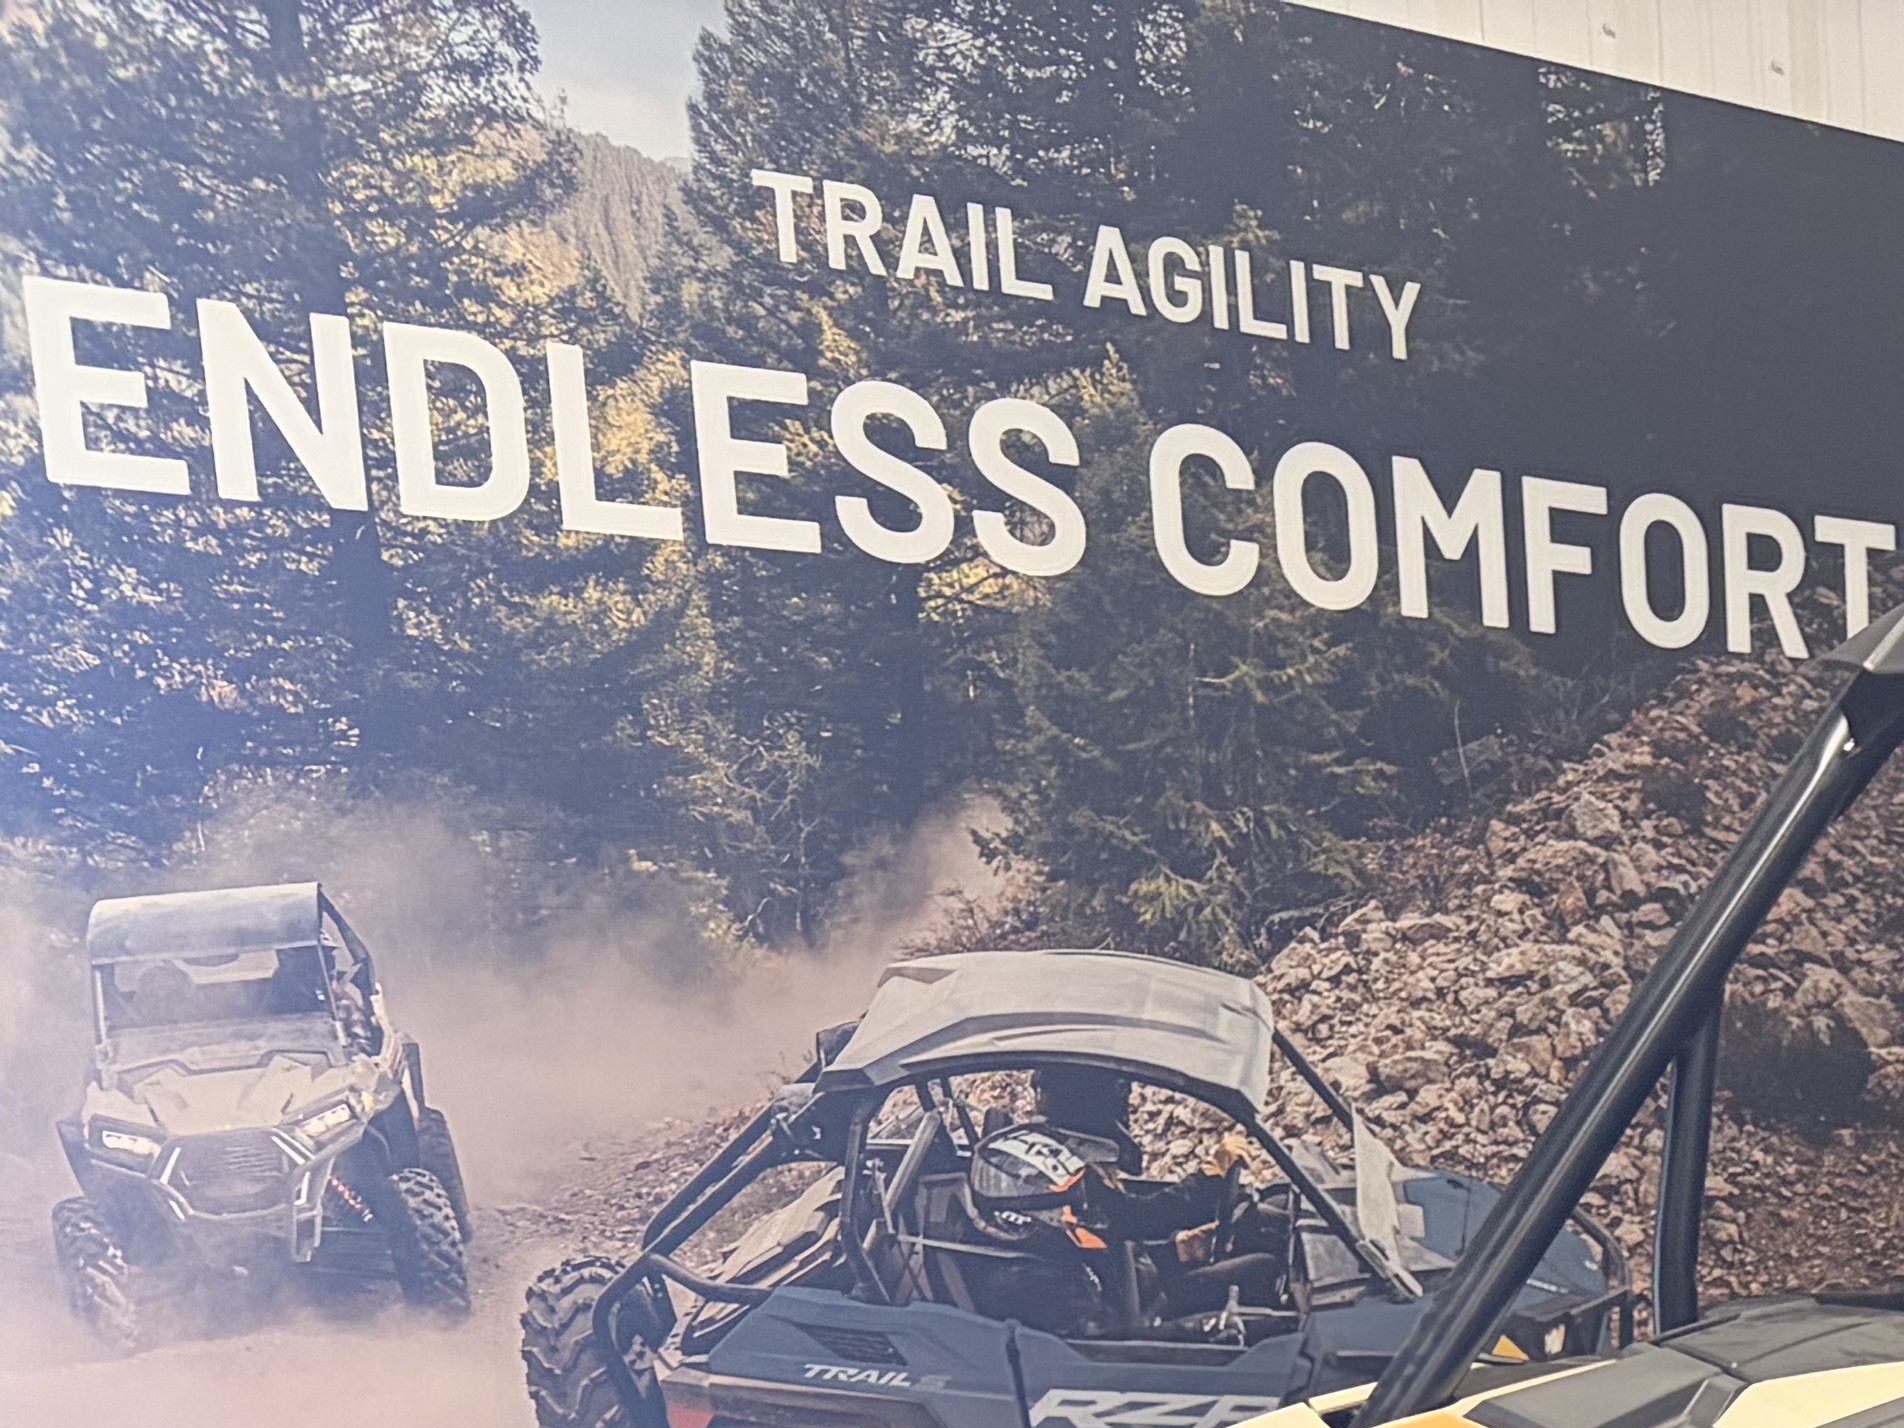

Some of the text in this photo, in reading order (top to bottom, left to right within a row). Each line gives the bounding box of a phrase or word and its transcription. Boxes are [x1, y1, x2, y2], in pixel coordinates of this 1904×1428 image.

[751, 168, 1422, 360] TRAIL AGILITY
[24, 276, 1898, 659] ENDLESS COMFORT
[803, 1363, 913, 1388] TRAIL
